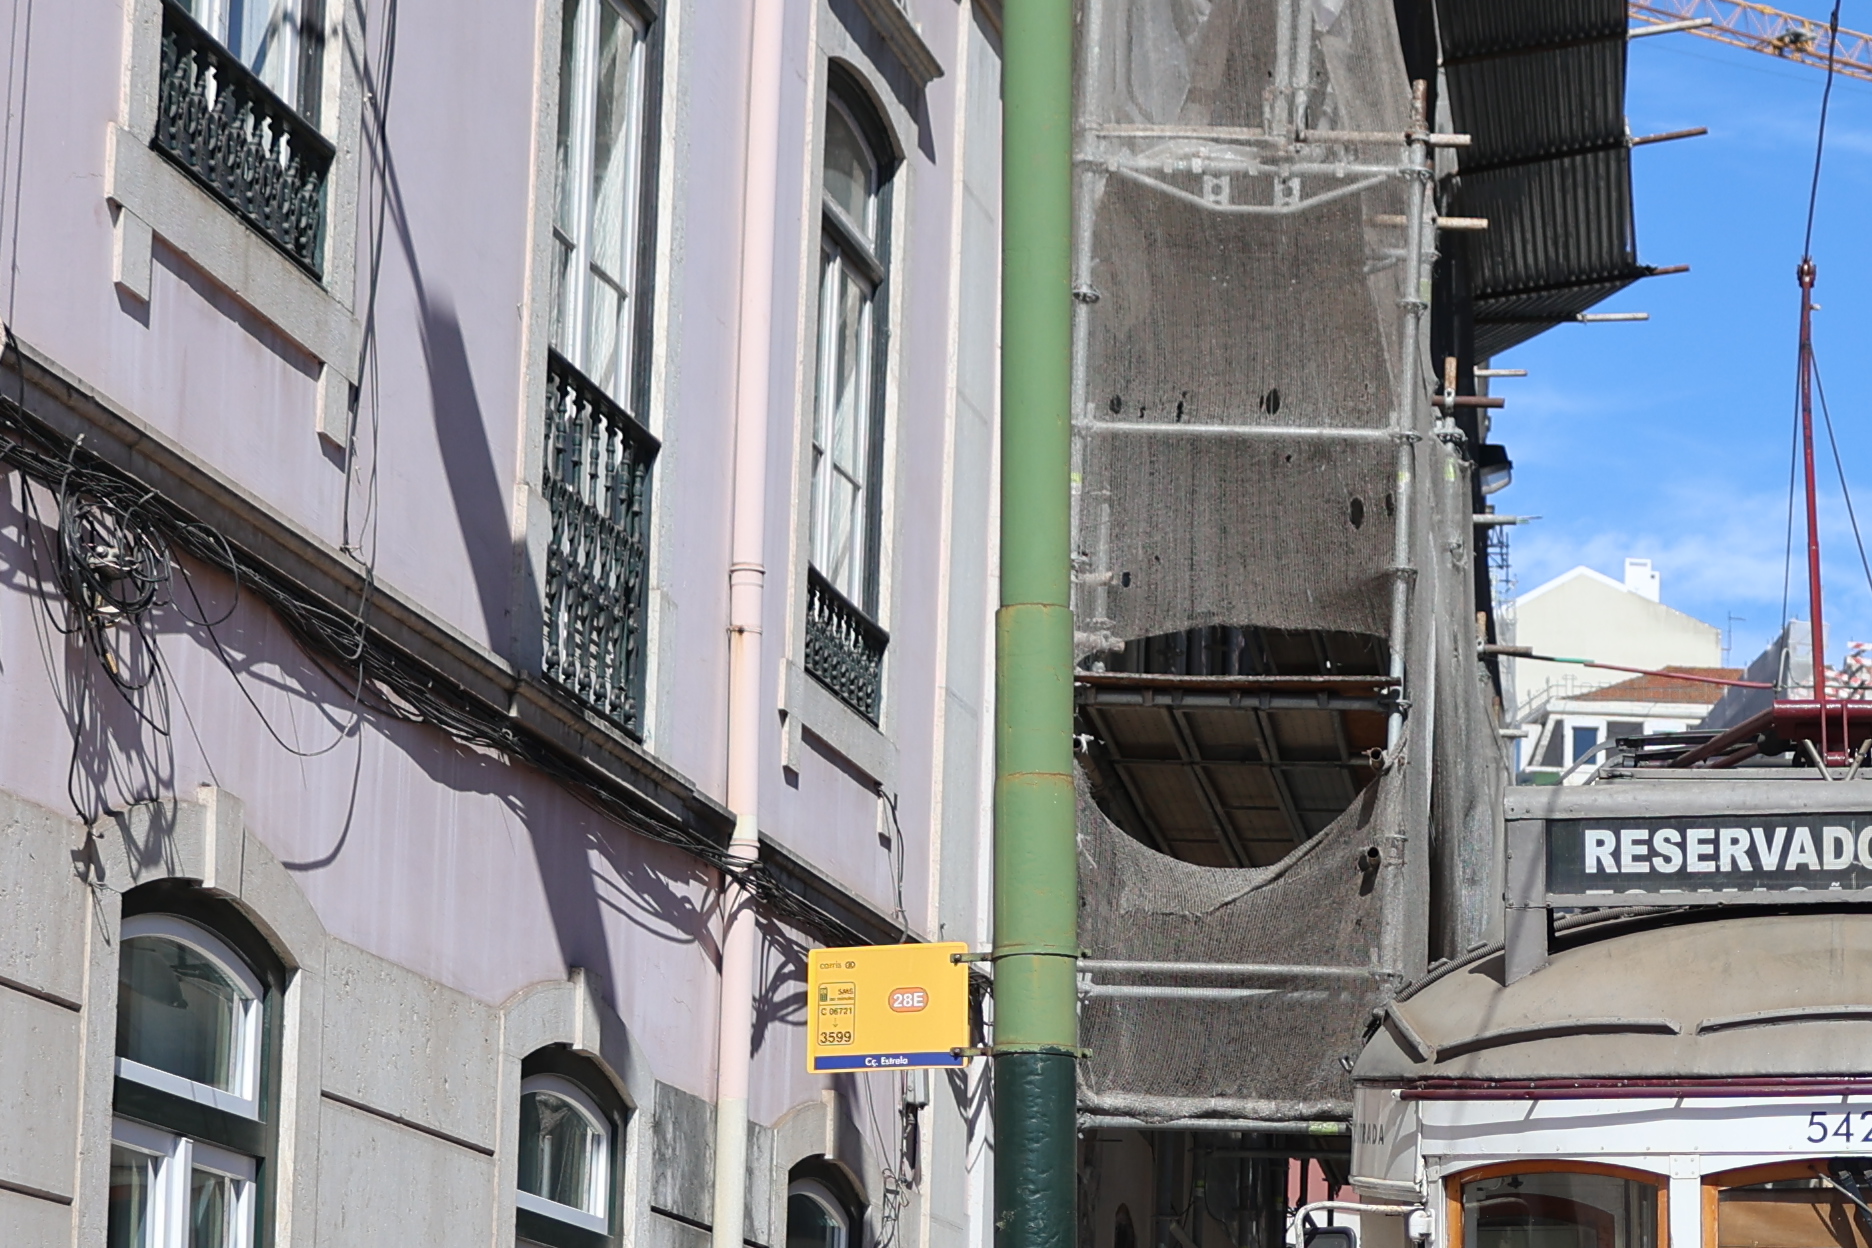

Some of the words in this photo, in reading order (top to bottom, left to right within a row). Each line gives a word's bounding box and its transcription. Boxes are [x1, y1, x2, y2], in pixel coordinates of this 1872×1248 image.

[893, 992, 924, 1008] 28E
[820, 1031, 852, 1044] 3599
[880, 1055, 908, 1065] Estrela
